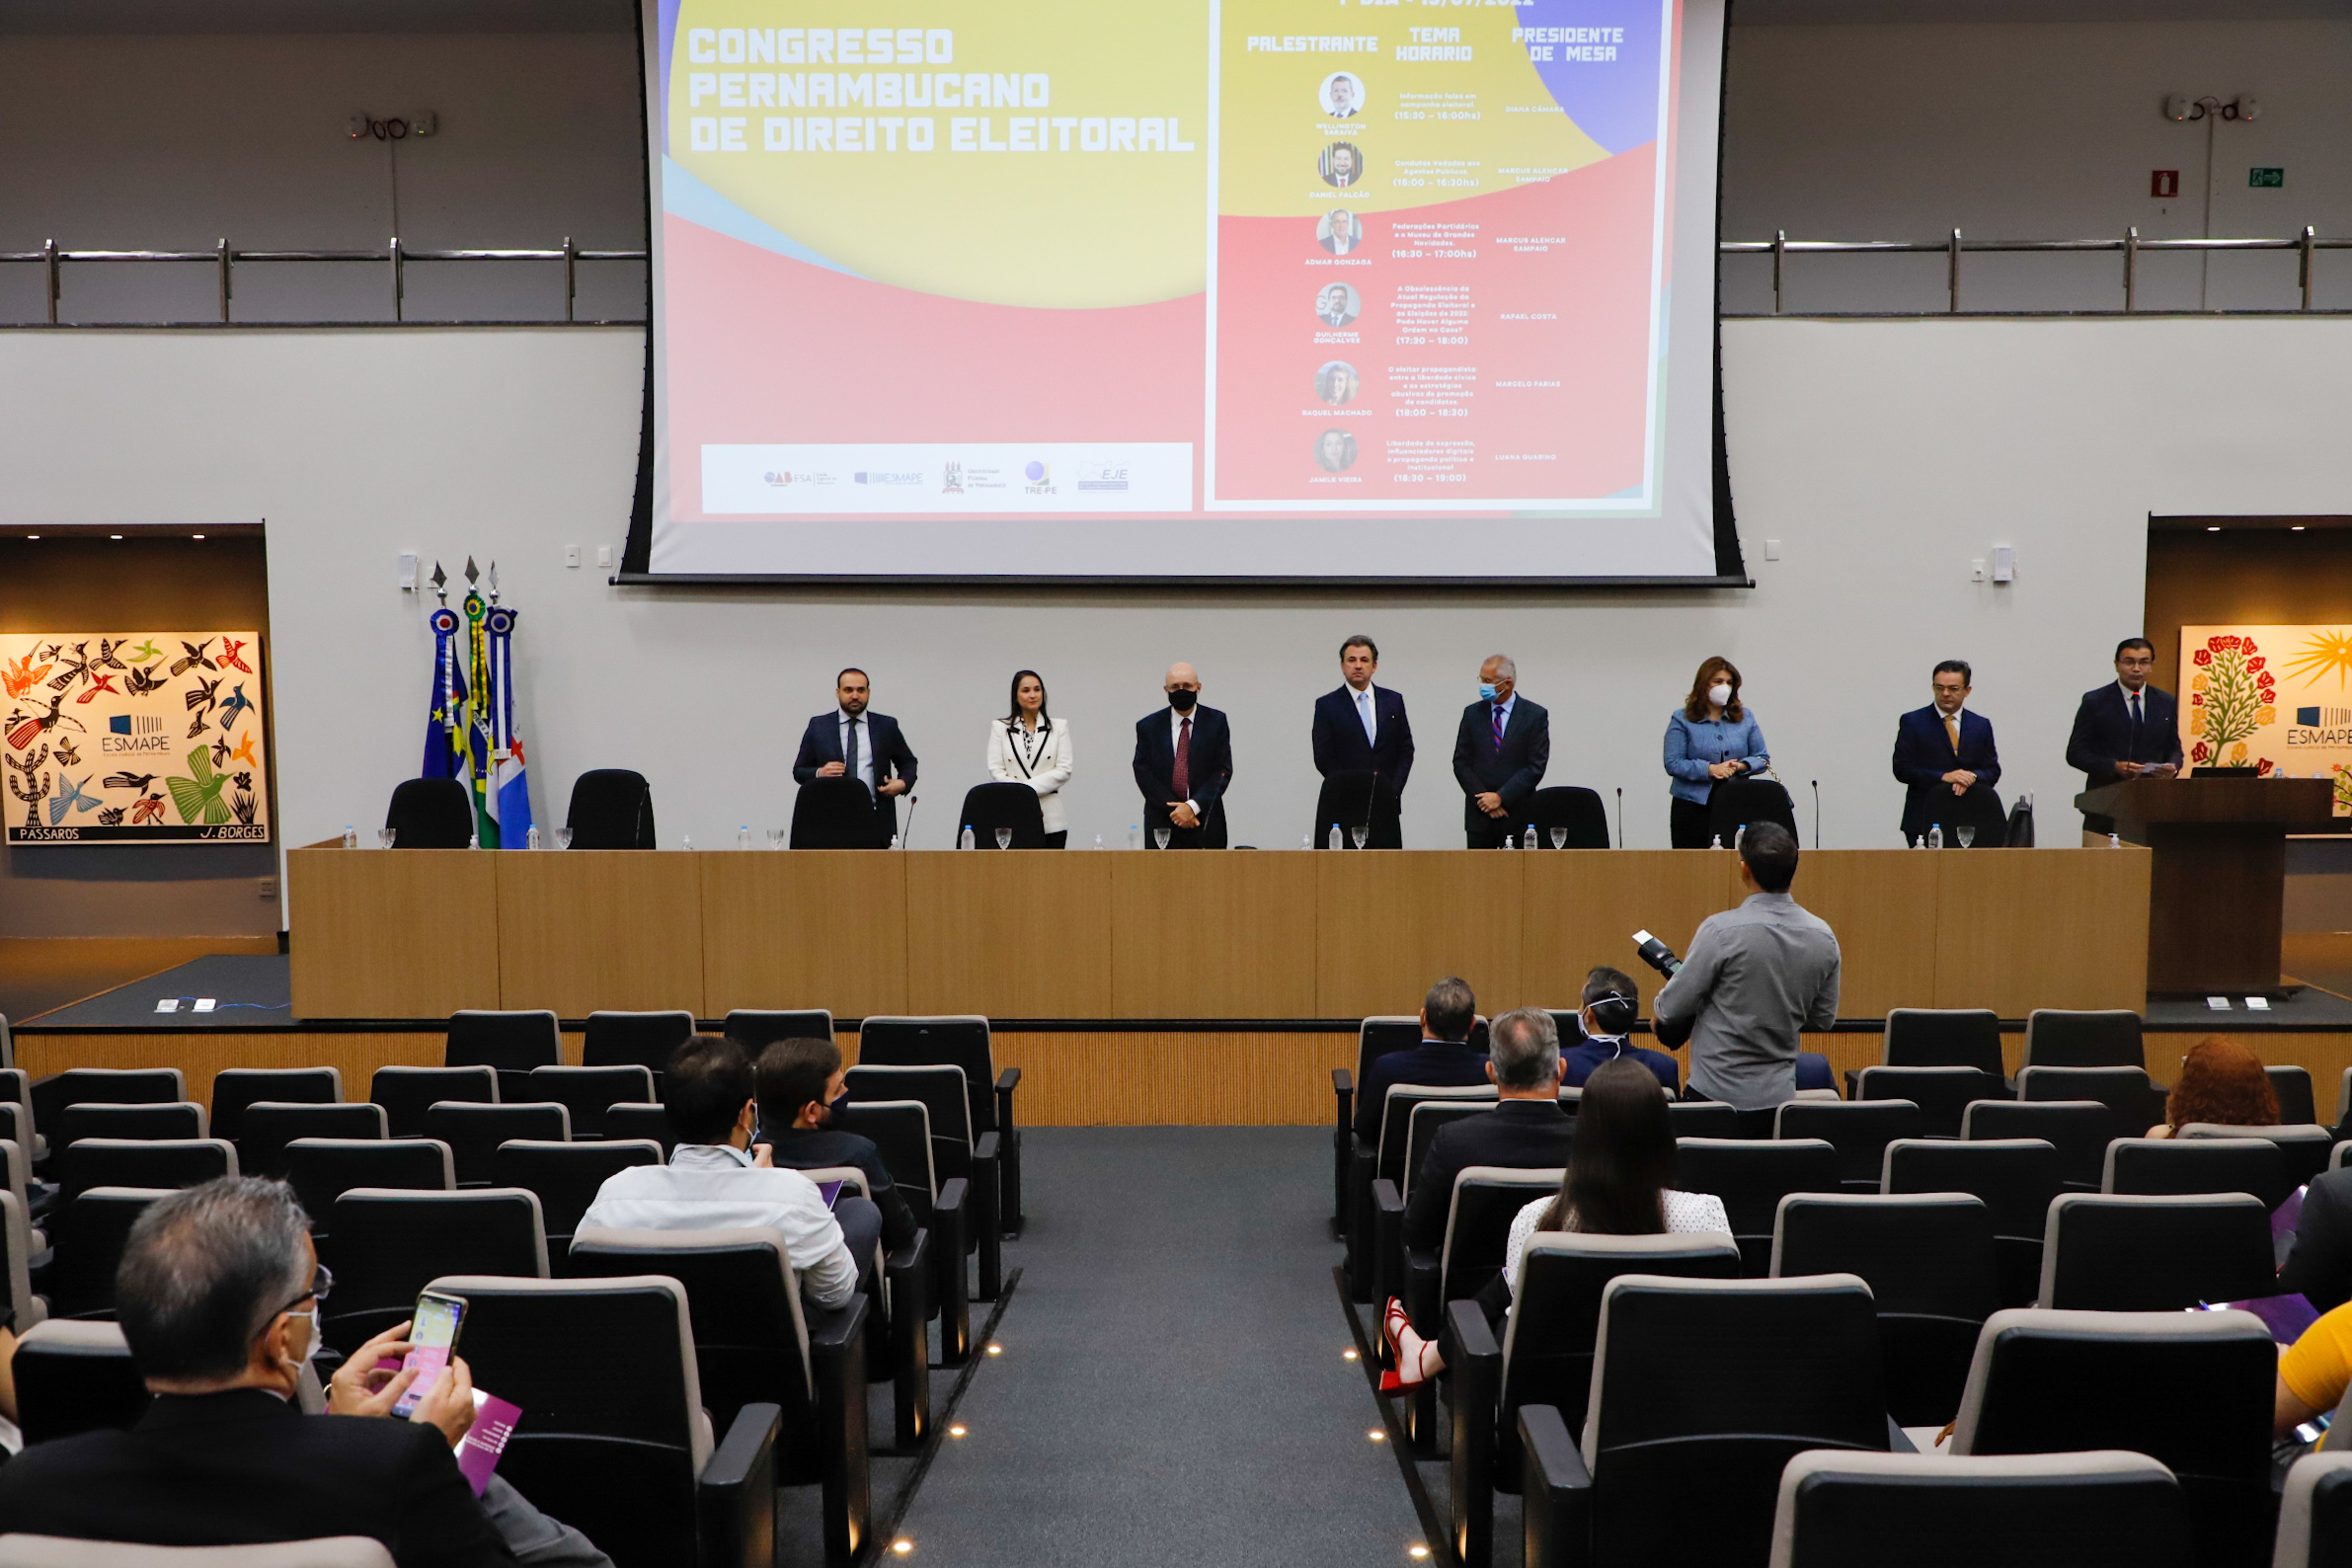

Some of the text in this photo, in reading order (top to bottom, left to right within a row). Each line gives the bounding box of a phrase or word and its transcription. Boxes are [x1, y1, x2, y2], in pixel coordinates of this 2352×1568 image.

[1409, 27, 1460, 43] TEMA
[1512, 27, 1624, 43] PRESIDENTE
[688, 29, 953, 64] CONGRESSO
[1247, 36, 1378, 51] PALESTRANTE
[1395, 45, 1472, 61] HORARIO
[1530, 45, 1617, 61] DE MESA
[689, 73, 1050, 108] PERNAMBUCANO
[690, 117, 1195, 152] DE DIREITO ELEITORAL
[1396, 336, 1426, 345] (17:30
[1437, 336, 1468, 345] 18:00)
[1395, 408, 1427, 417] (18:00
[1438, 408, 1468, 417] 18:30)
[794, 474, 813, 483] ESA
[885, 473, 923, 483] ESMAPE
[1102, 469, 1129, 480] EJE
[1025, 486, 1057, 495] TRE-PE
[102, 736, 171, 752] ESMAPE
